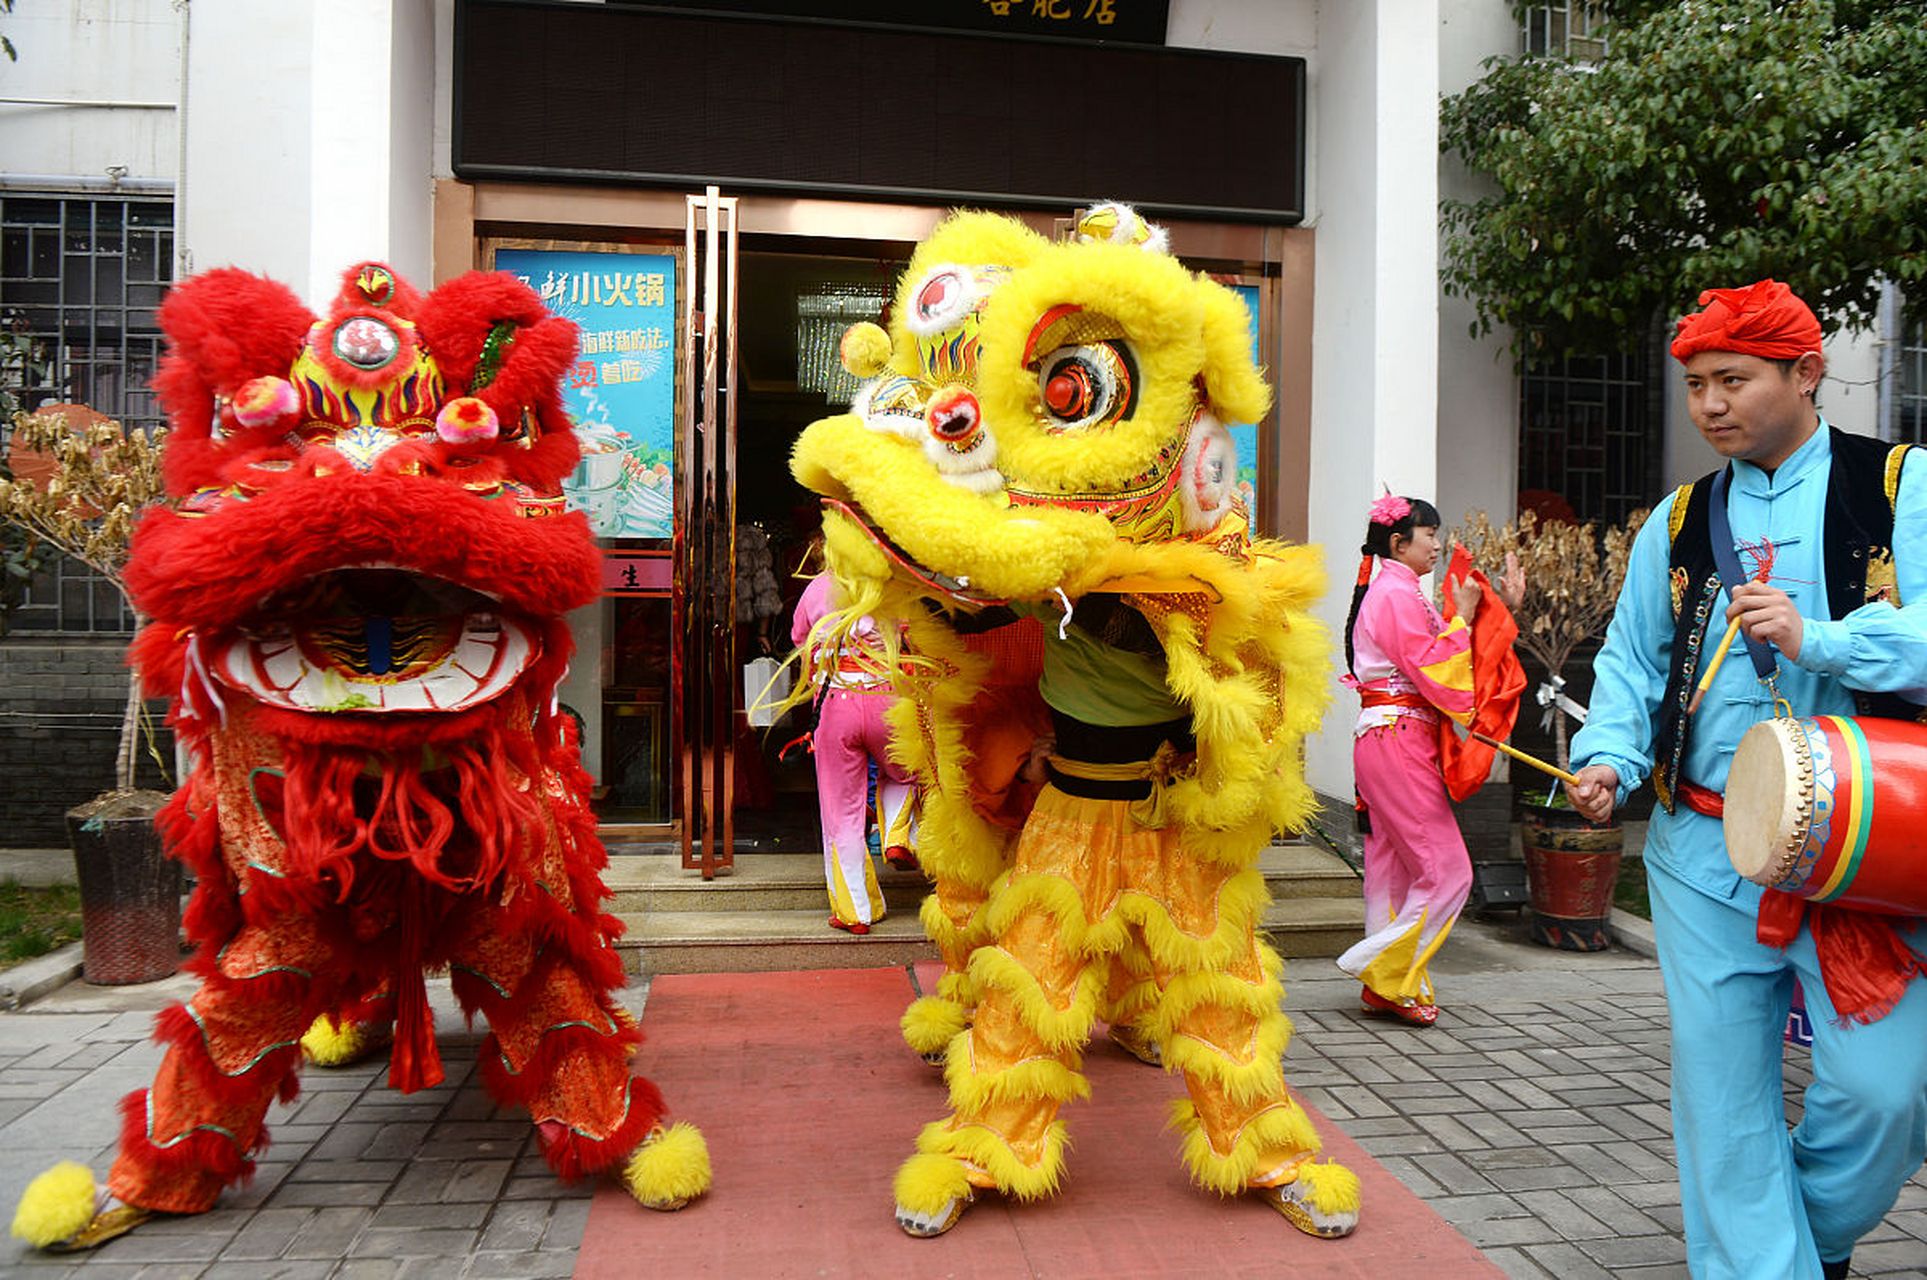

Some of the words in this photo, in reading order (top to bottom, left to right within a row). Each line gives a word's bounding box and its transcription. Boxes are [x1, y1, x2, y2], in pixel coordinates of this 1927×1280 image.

[517, 270, 665, 307] 鲜小火锅
[621, 564, 640, 587] 生
